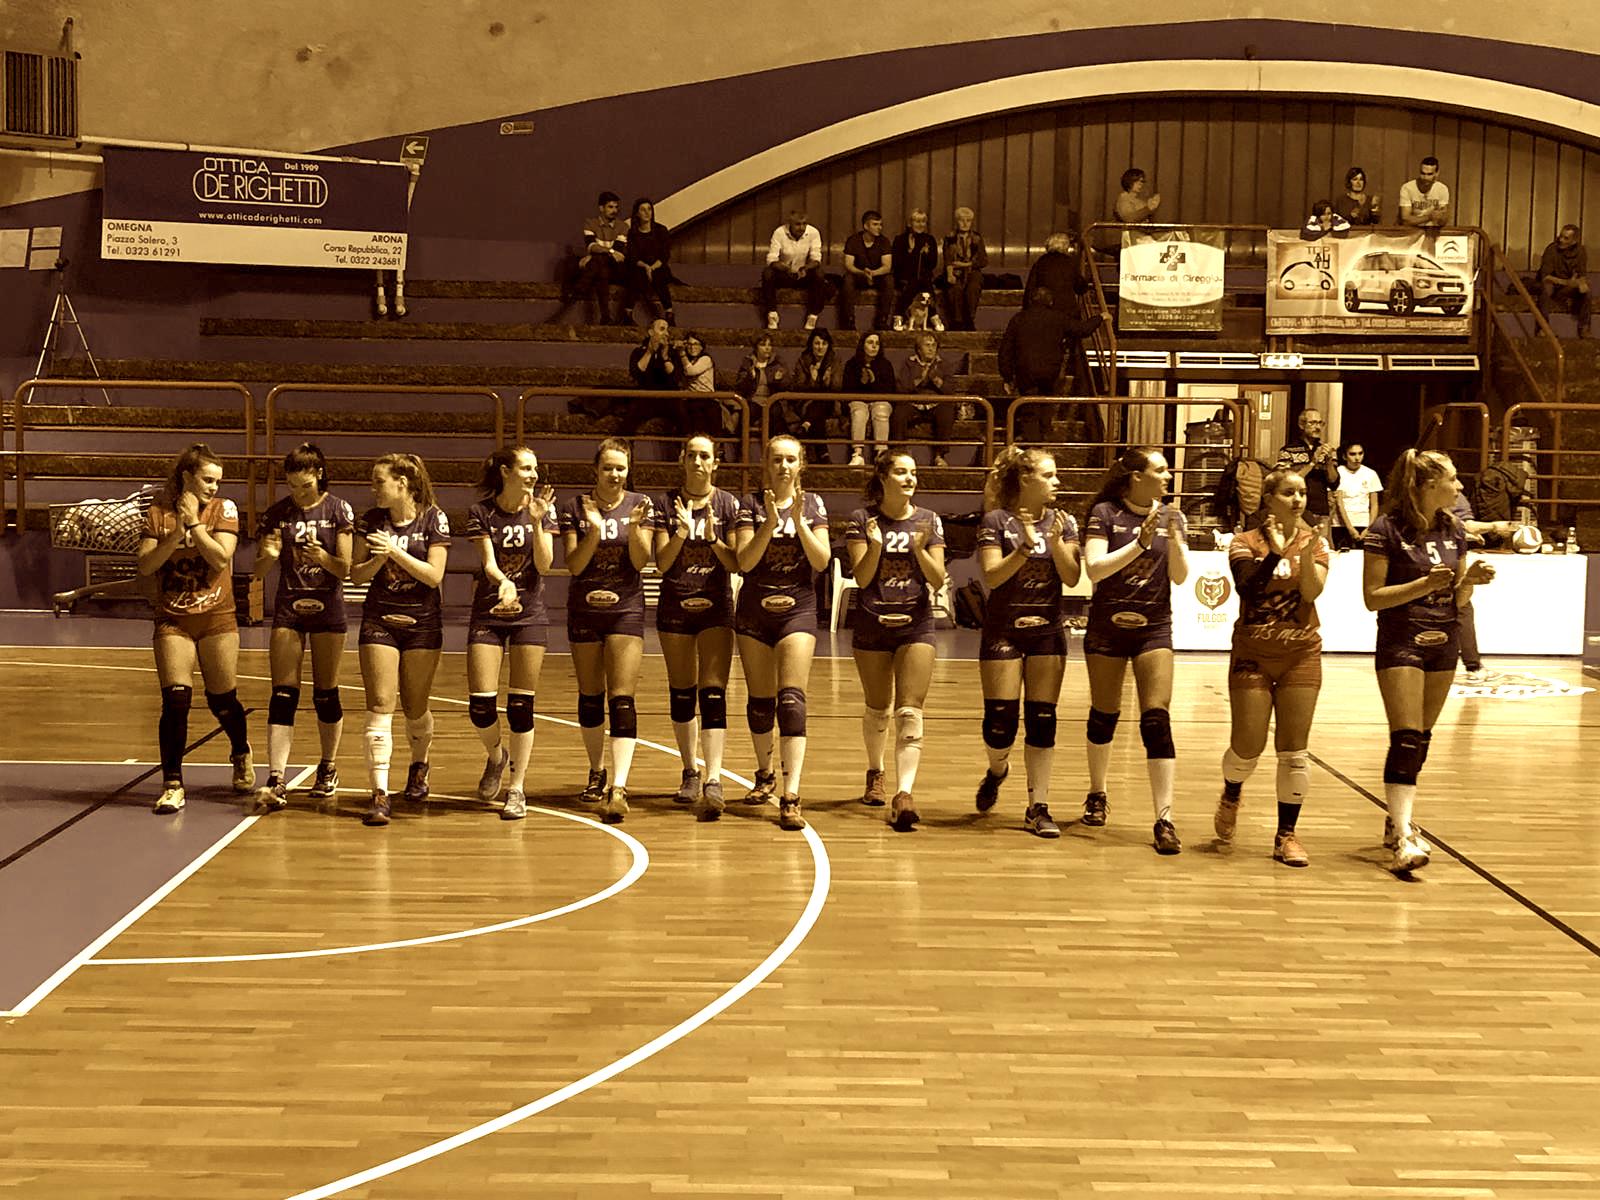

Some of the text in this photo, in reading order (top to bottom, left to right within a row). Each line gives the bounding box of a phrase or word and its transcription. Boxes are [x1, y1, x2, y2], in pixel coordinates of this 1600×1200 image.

[203, 157, 271, 175] OTTICA
[284, 162, 319, 171] Dal 1909
[204, 173, 320, 203] DE RIGHETTI
[199, 212, 322, 224] www.otticaderighetti.com
[107, 222, 153, 232] OMEGNA
[107, 234, 135, 244] Piazza
[171, 236, 178, 245] 3
[372, 235, 403, 243] ARONA
[107, 246, 181, 257] Tel. 0323 61291
[323, 243, 402, 255] Corso Repubblica, 22
[335, 255, 401, 265] Tel. 0322 243681
[1124, 274, 1166, 282] Farmacia
[1169, 274, 1178, 282] di
[599, 518, 618, 541] 13
[502, 525, 525, 548] 23
[885, 531, 910, 553] 22
[1425, 541, 1442, 565] 5
